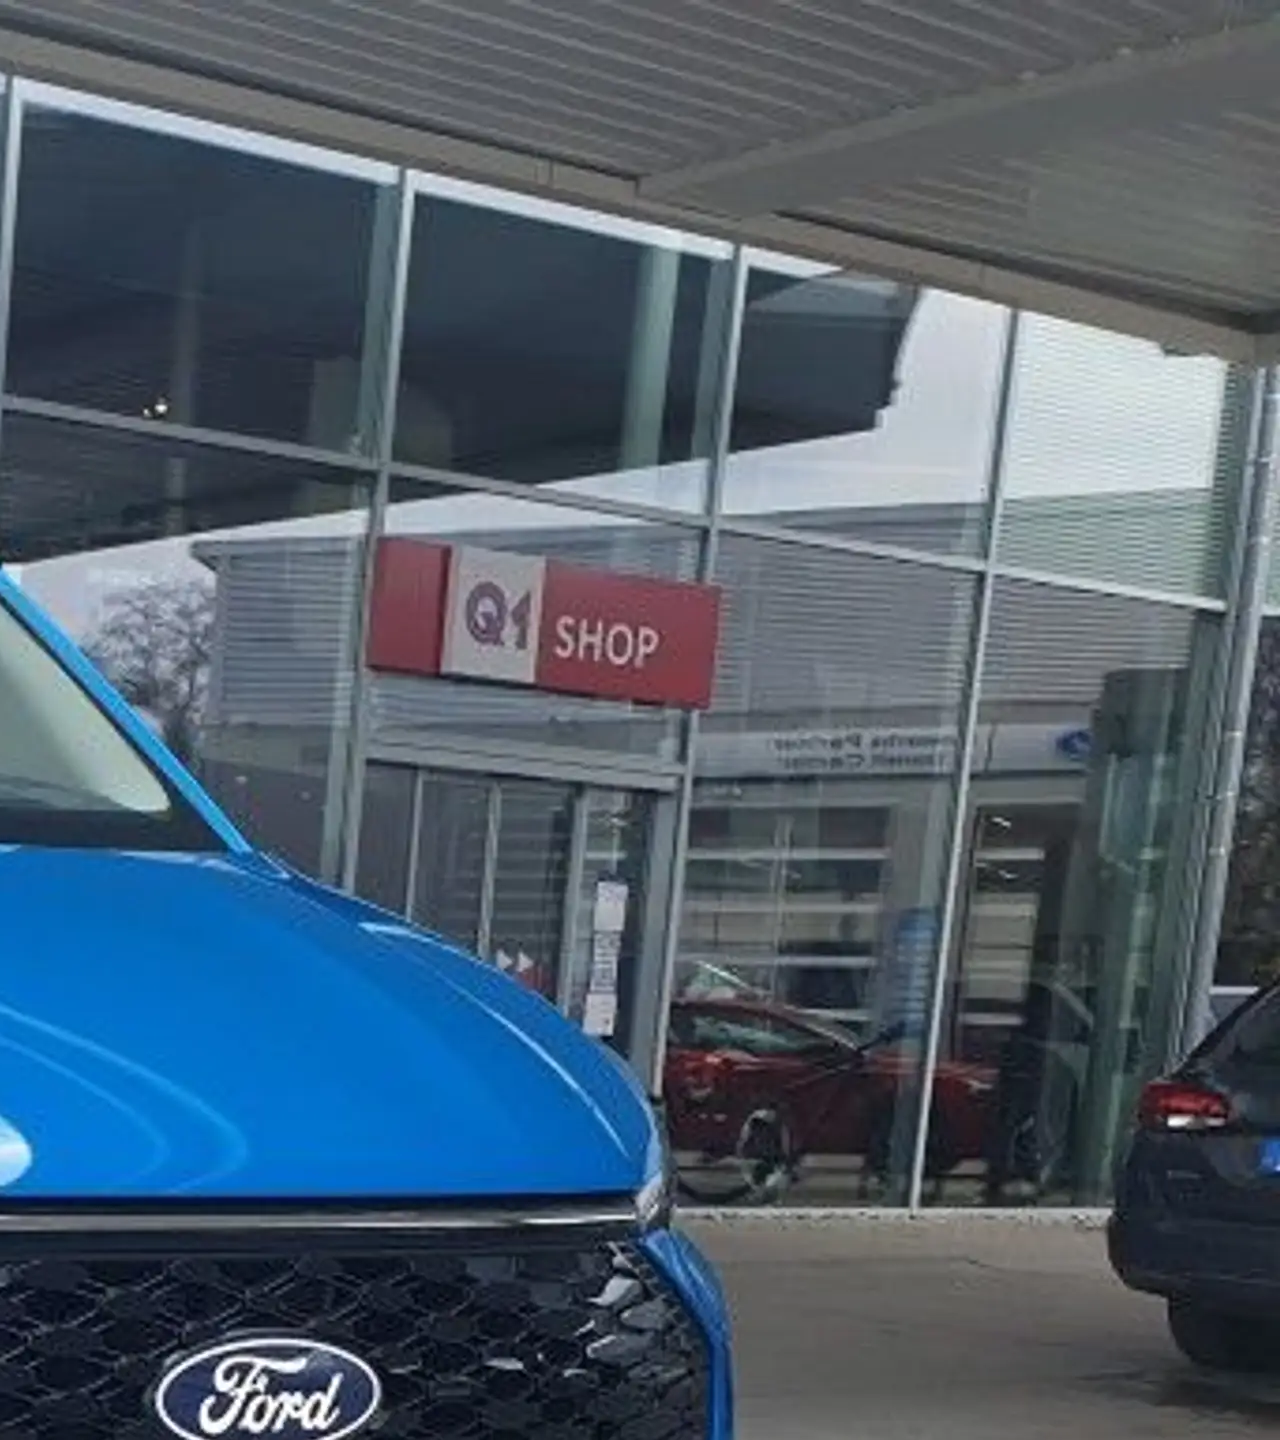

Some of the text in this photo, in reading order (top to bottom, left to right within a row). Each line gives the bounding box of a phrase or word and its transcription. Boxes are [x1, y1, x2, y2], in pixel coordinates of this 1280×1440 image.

[466, 581, 660, 669] Q1 SHOP
[198, 1355, 344, 1435] Ford
